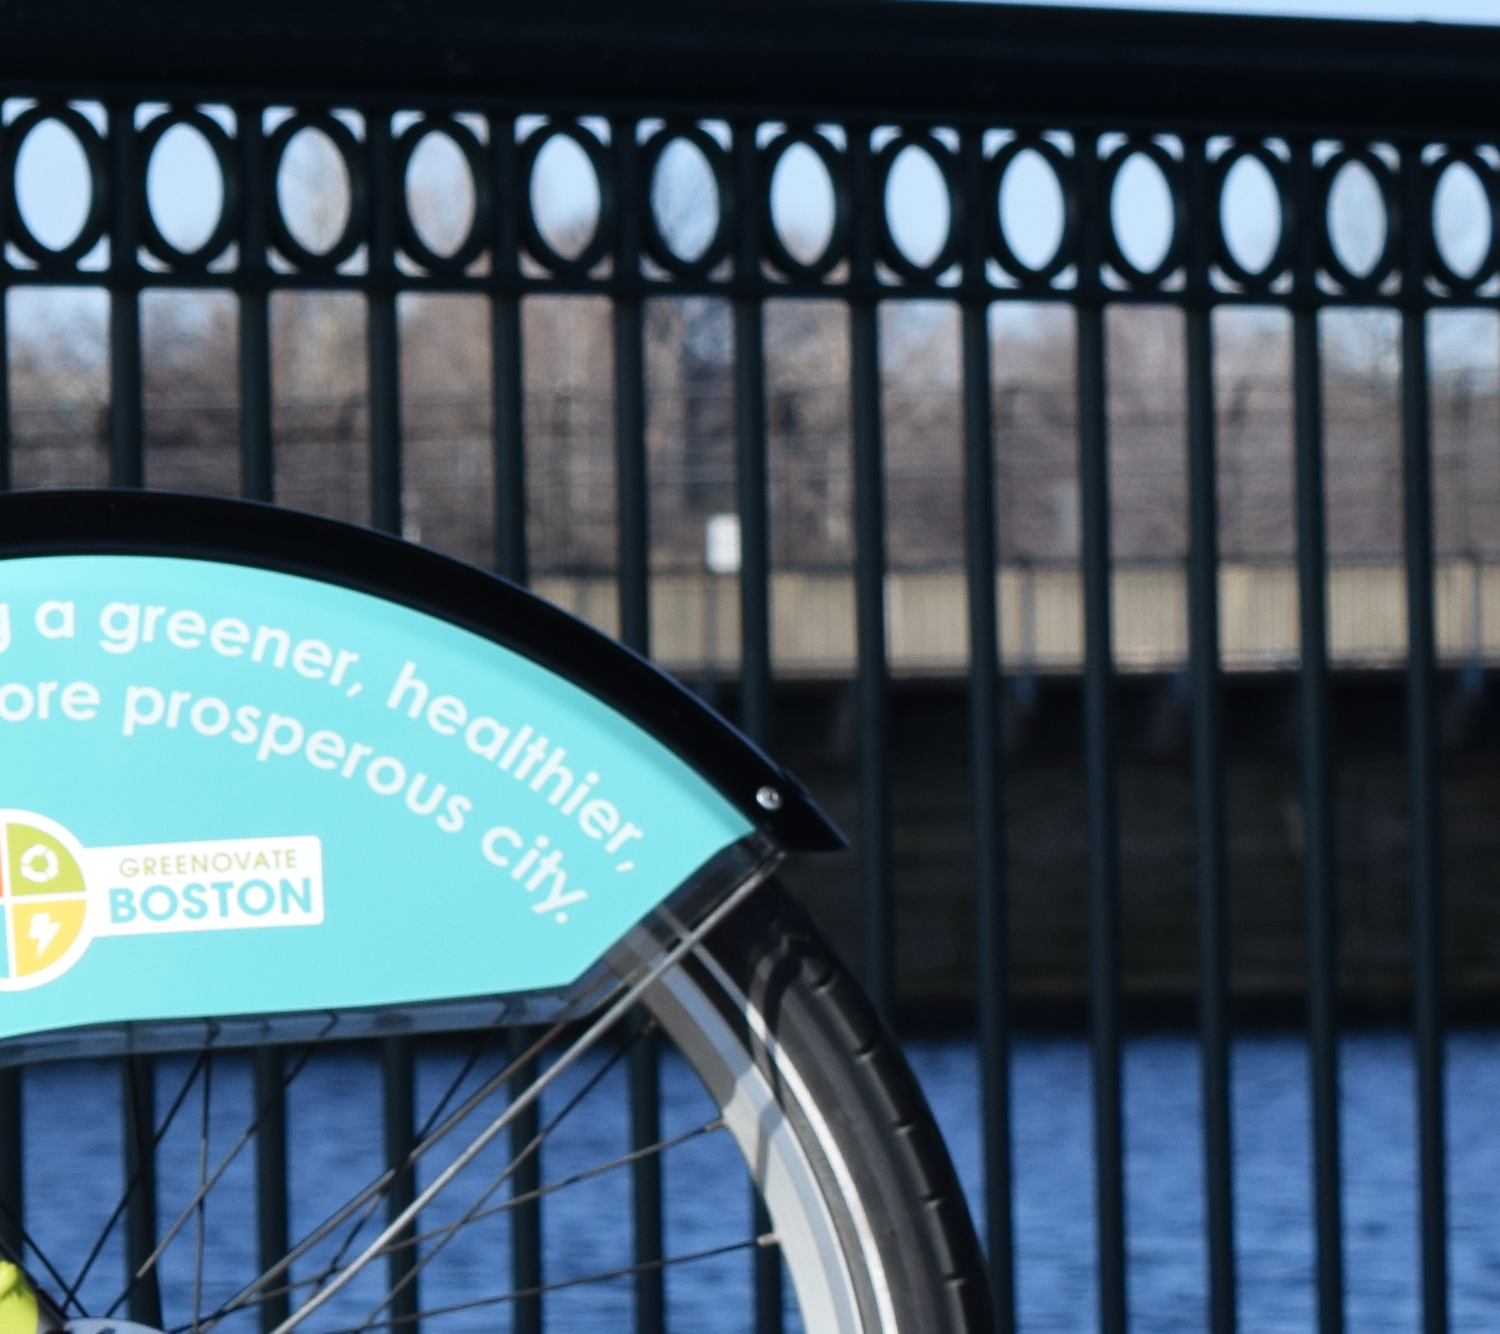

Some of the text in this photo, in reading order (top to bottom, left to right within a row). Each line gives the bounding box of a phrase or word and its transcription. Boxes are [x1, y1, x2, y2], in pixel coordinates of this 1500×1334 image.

[34, 600, 75, 641] a
[99, 600, 363, 698] greener,
[386, 661, 644, 875] healthier,
[121, 684, 472, 834] prosperous
[482, 825, 588, 925] city.
[107, 876, 313, 925] BOSTON
[117, 848, 298, 879] GREENOVATE
